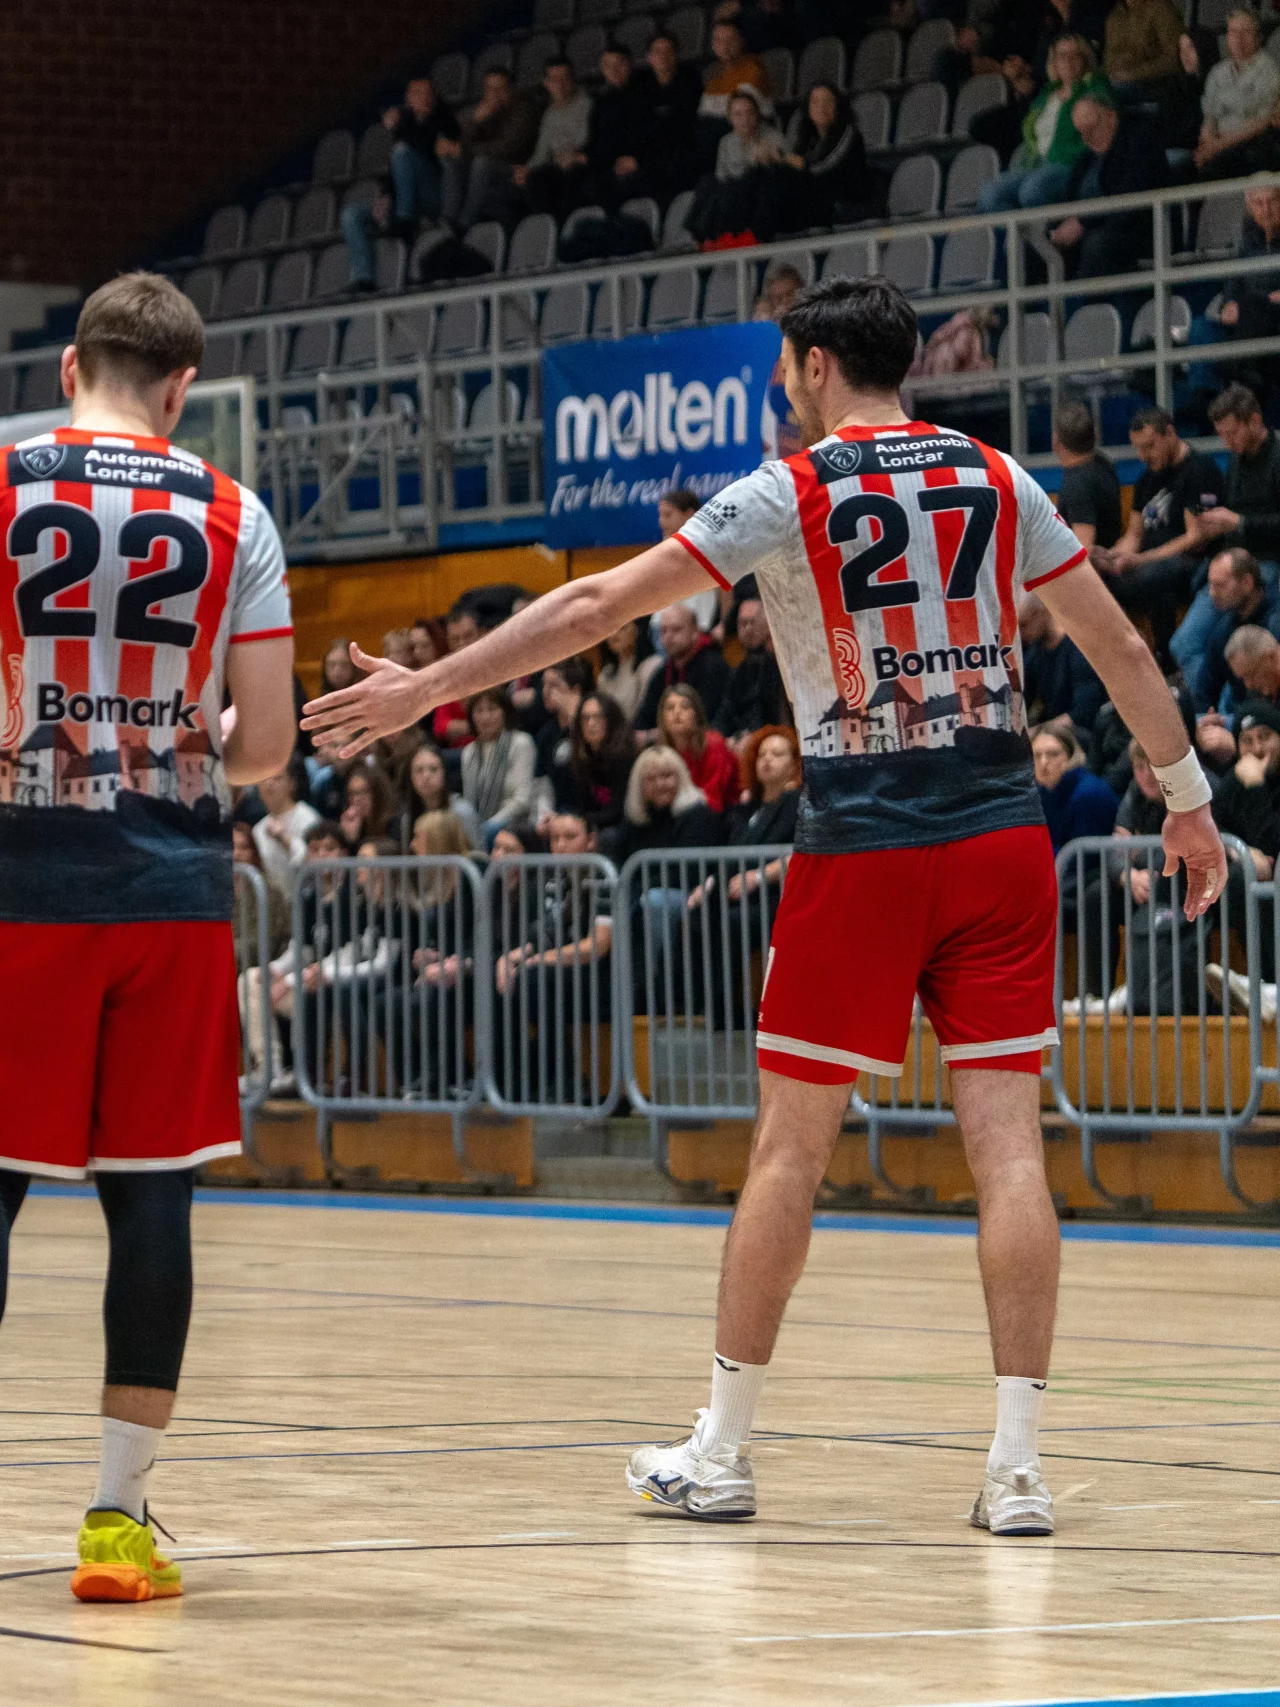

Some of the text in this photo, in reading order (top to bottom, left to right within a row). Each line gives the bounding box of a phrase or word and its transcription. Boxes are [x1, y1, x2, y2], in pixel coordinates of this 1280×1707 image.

[555, 371, 748, 463] molten
[83, 449, 205, 478] Automobil
[875, 437, 972, 453] Automobil
[878, 451, 944, 467] Lončar
[84, 463, 166, 485] Lončar
[589, 467, 628, 509] the
[826, 485, 999, 614] 27
[8, 502, 210, 648] 22
[36, 682, 200, 730] Bomark
